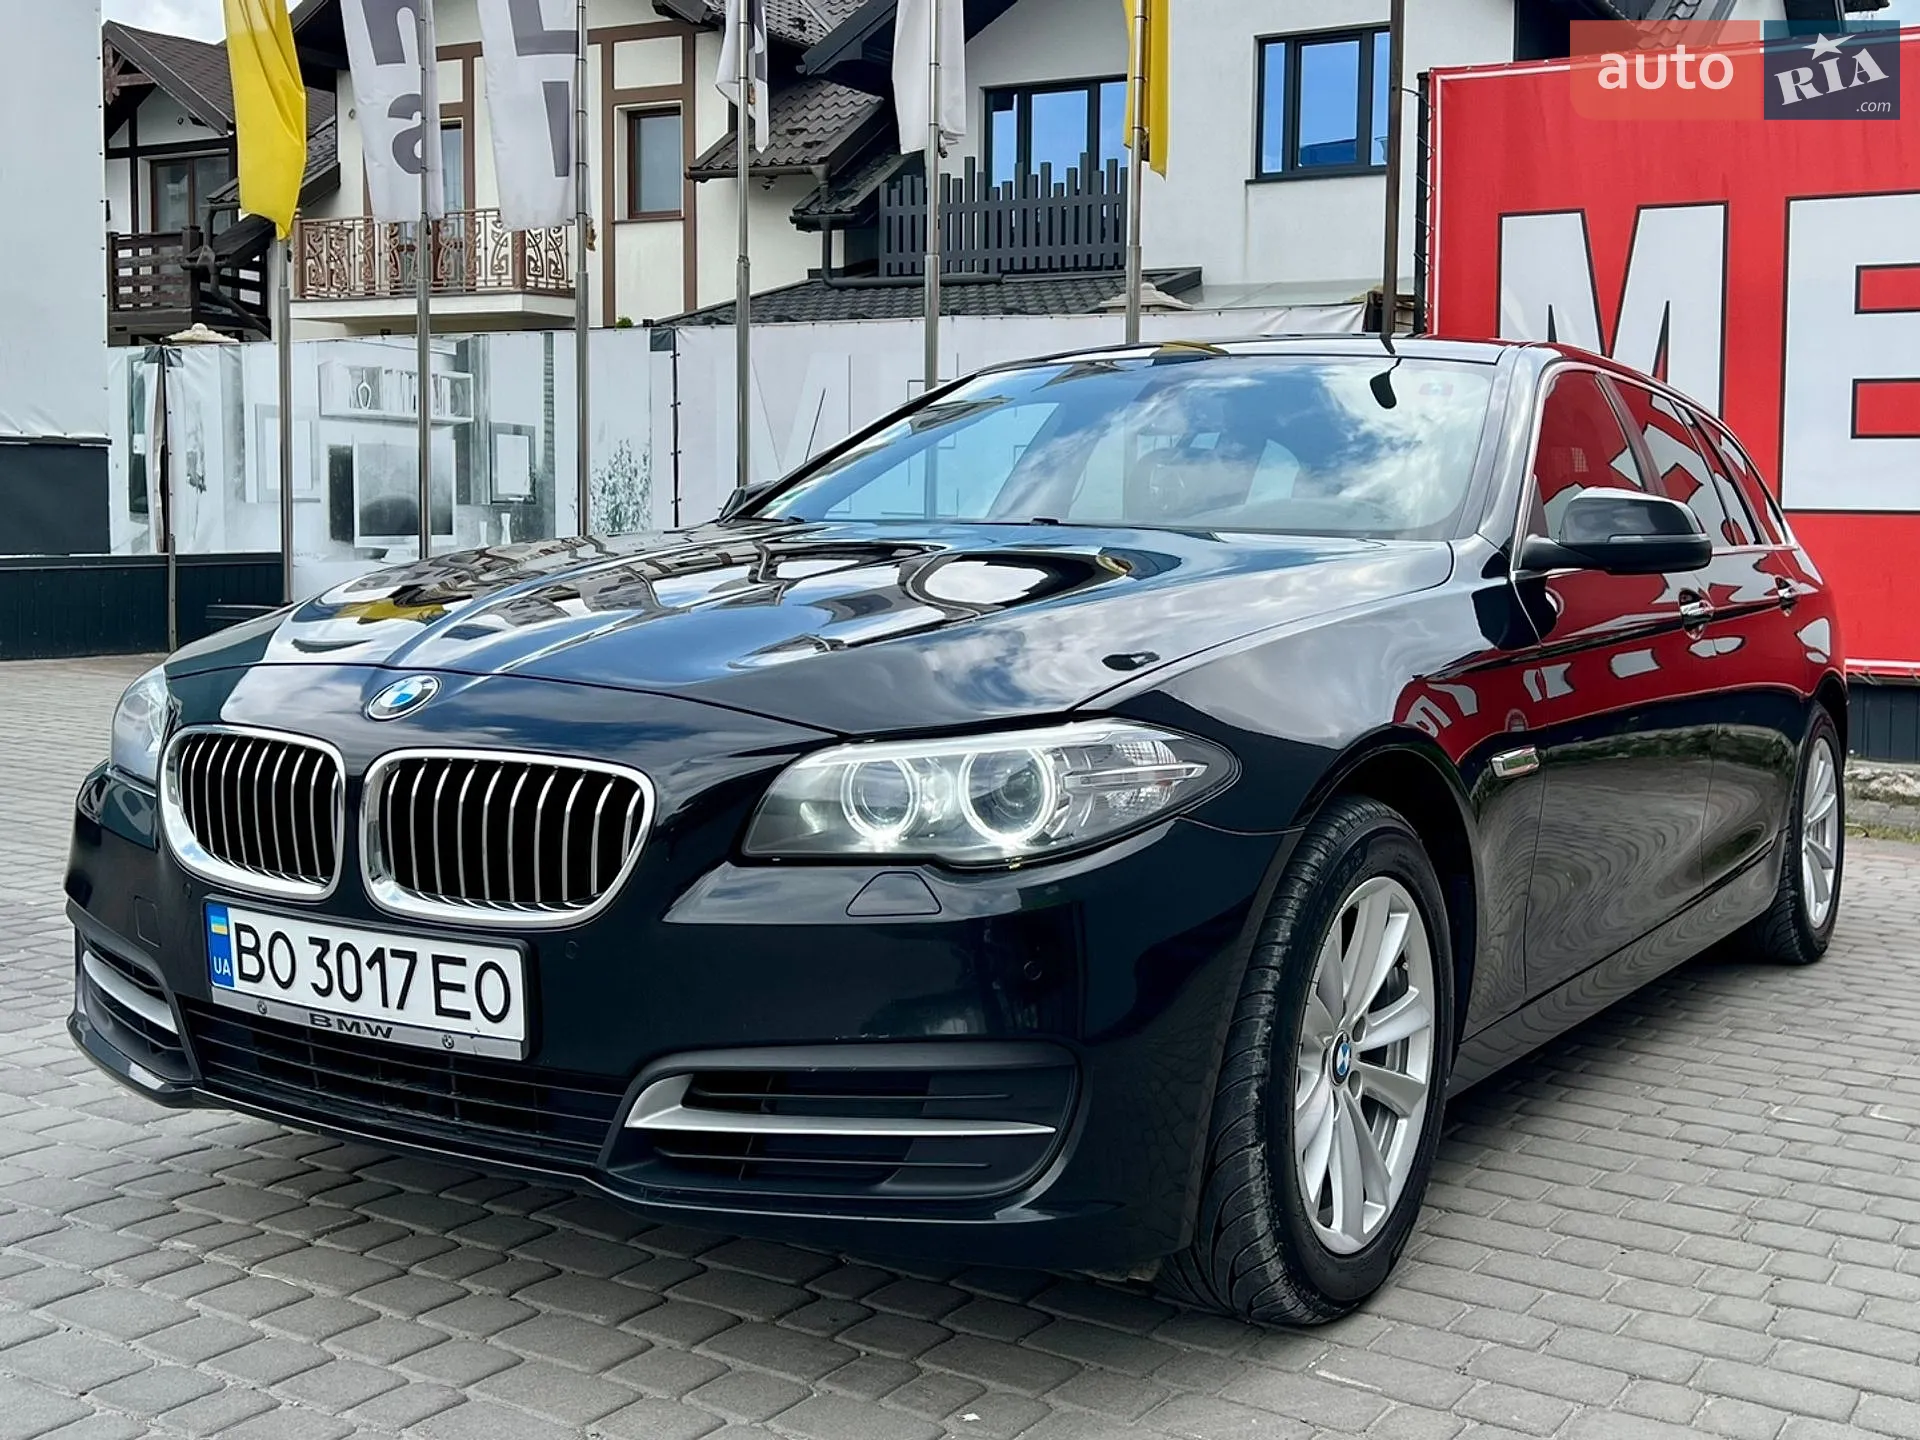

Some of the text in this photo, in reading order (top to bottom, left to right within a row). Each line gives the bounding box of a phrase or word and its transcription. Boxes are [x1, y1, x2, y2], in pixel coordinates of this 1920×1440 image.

[213, 955, 232, 978] UA
[233, 922, 512, 1023] BO 3017 EO
[309, 1012, 393, 1039] BMW
